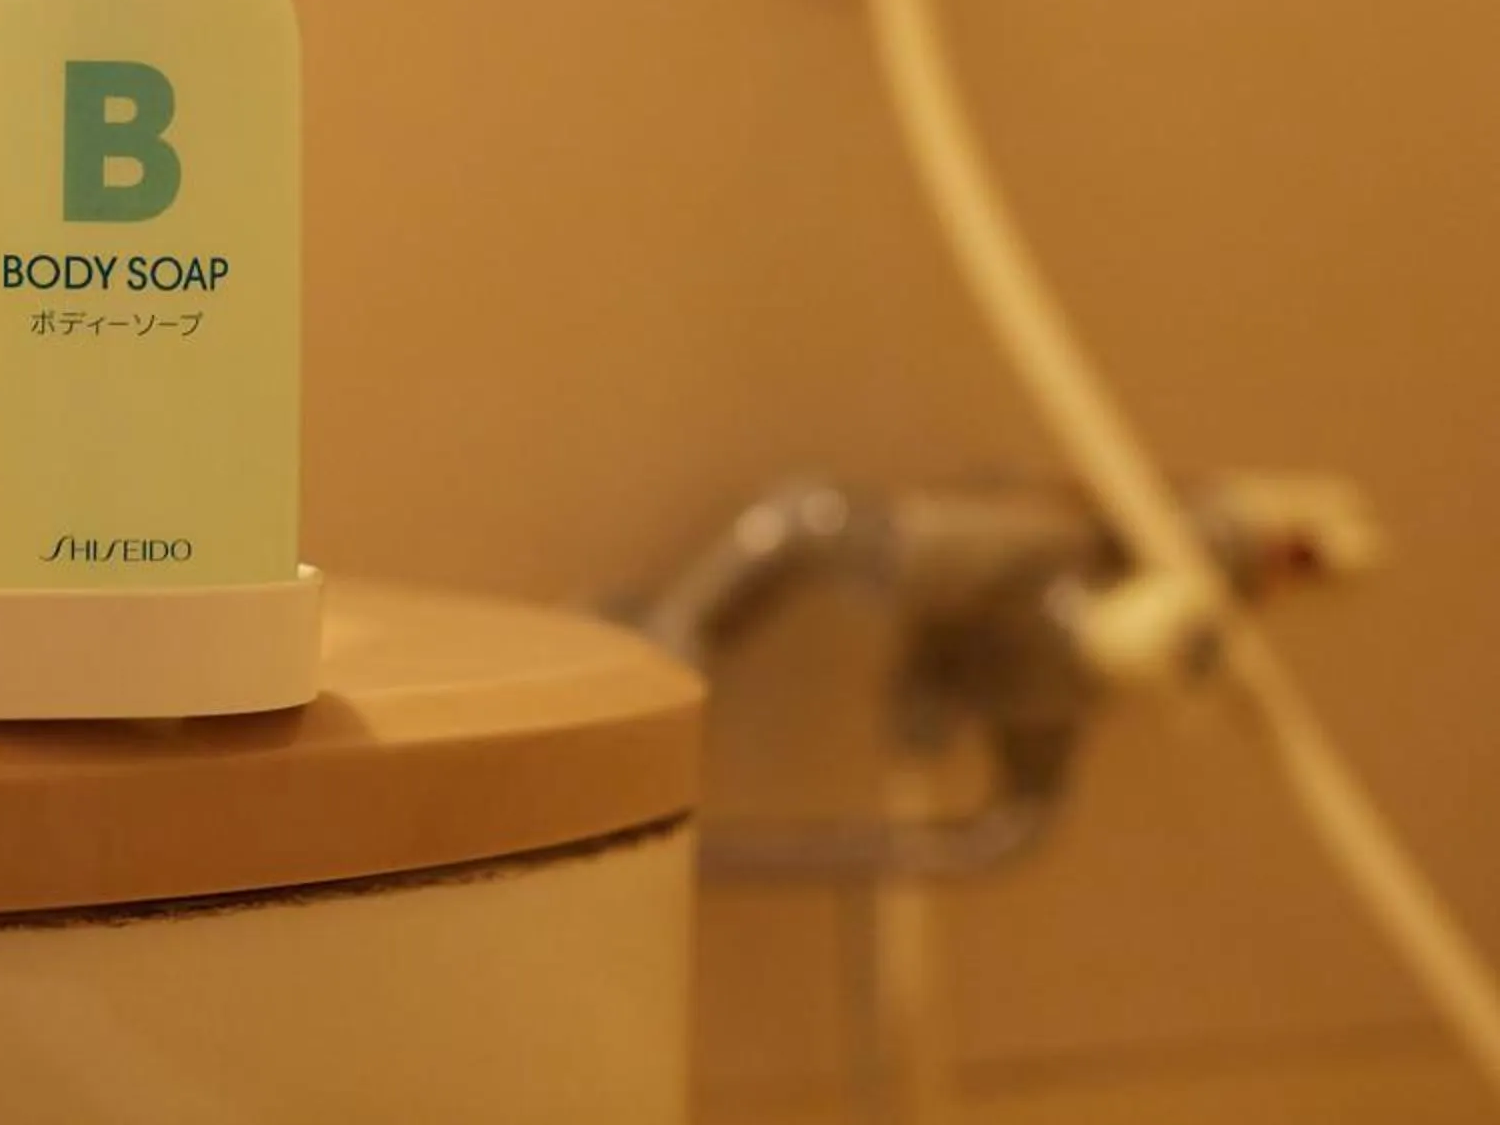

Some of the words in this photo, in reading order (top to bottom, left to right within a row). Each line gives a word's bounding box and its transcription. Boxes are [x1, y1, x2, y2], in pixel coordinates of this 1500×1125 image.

[63, 60, 182, 222] B
[2, 254, 117, 290] BODY
[127, 256, 229, 291] SOAP
[30, 309, 204, 337] ボディーソープ
[39, 535, 193, 563] SHISEIDO
